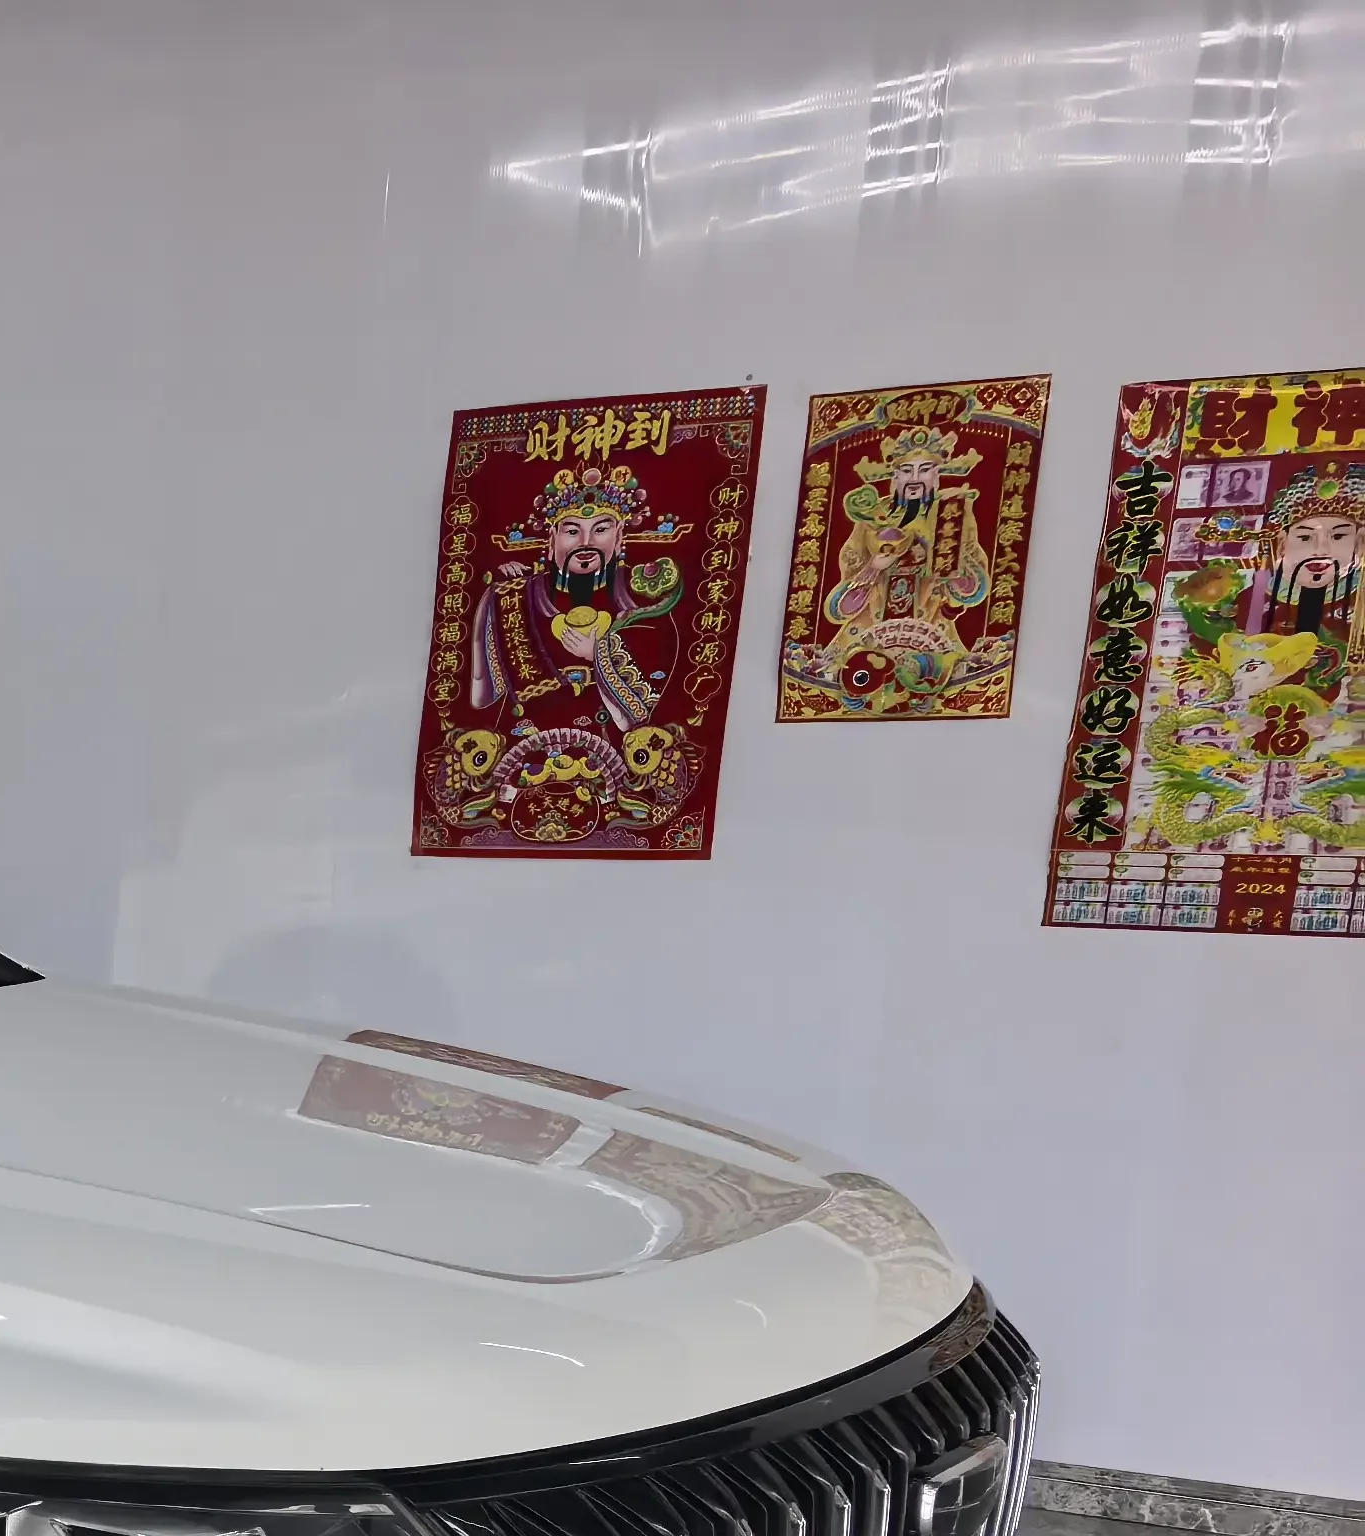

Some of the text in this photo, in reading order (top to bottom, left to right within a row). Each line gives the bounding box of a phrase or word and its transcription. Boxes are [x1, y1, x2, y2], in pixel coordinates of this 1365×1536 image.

[525, 409, 671, 462] 财神到
[434, 504, 471, 702] 福星高照福满堂
[693, 486, 742, 691] 财神到家财源广
[1065, 460, 1173, 843] 吉祥如意好运来
[1235, 882, 1286, 895] 2024
